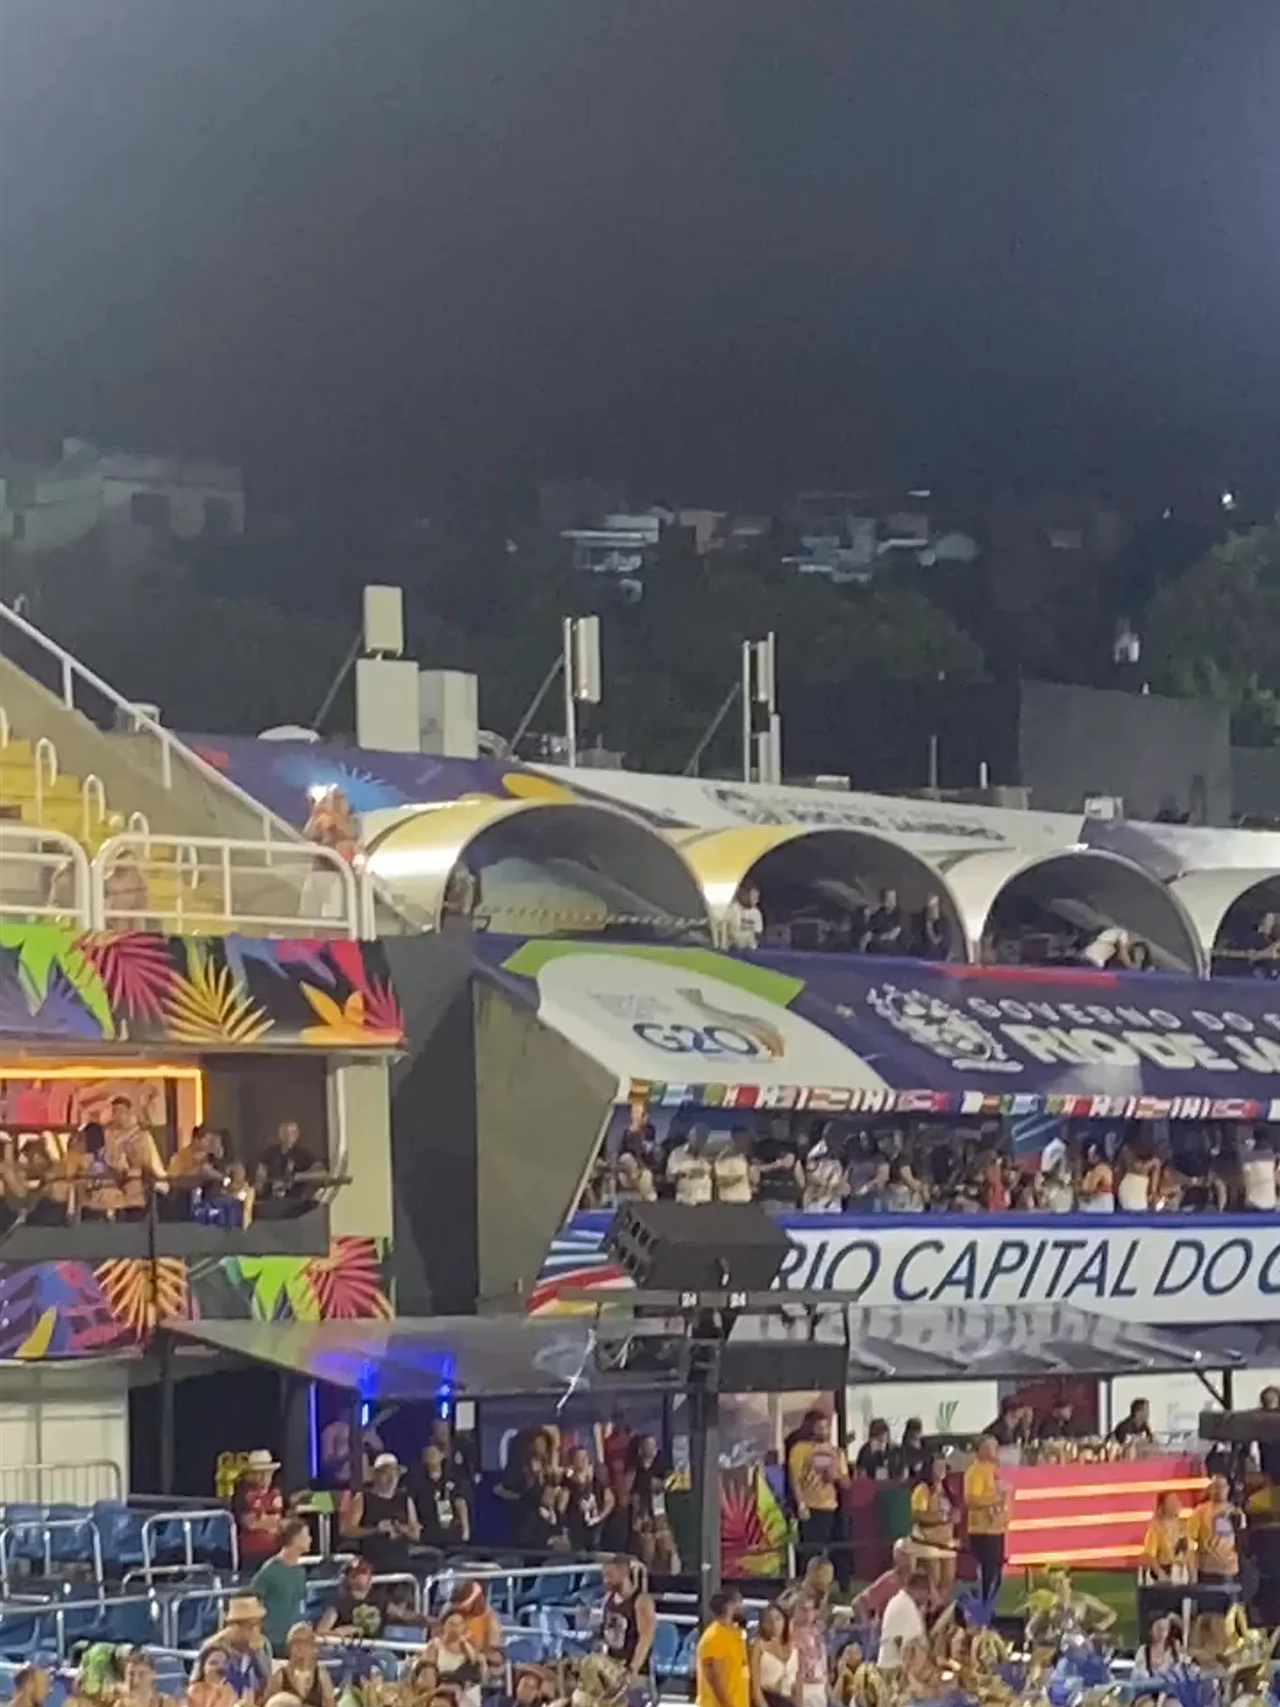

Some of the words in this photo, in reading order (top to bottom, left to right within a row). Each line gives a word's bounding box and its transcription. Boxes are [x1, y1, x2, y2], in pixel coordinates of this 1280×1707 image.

[967, 997, 1182, 1029] GOVERNO
[1191, 1009, 1254, 1032] DO
[632, 1024, 760, 1055] G20
[1000, 1023, 1140, 1066] RIO
[1121, 1029, 1239, 1071] DE
[893, 1239, 1141, 1302] CAPITAL
[1154, 1237, 1253, 1297] DO
